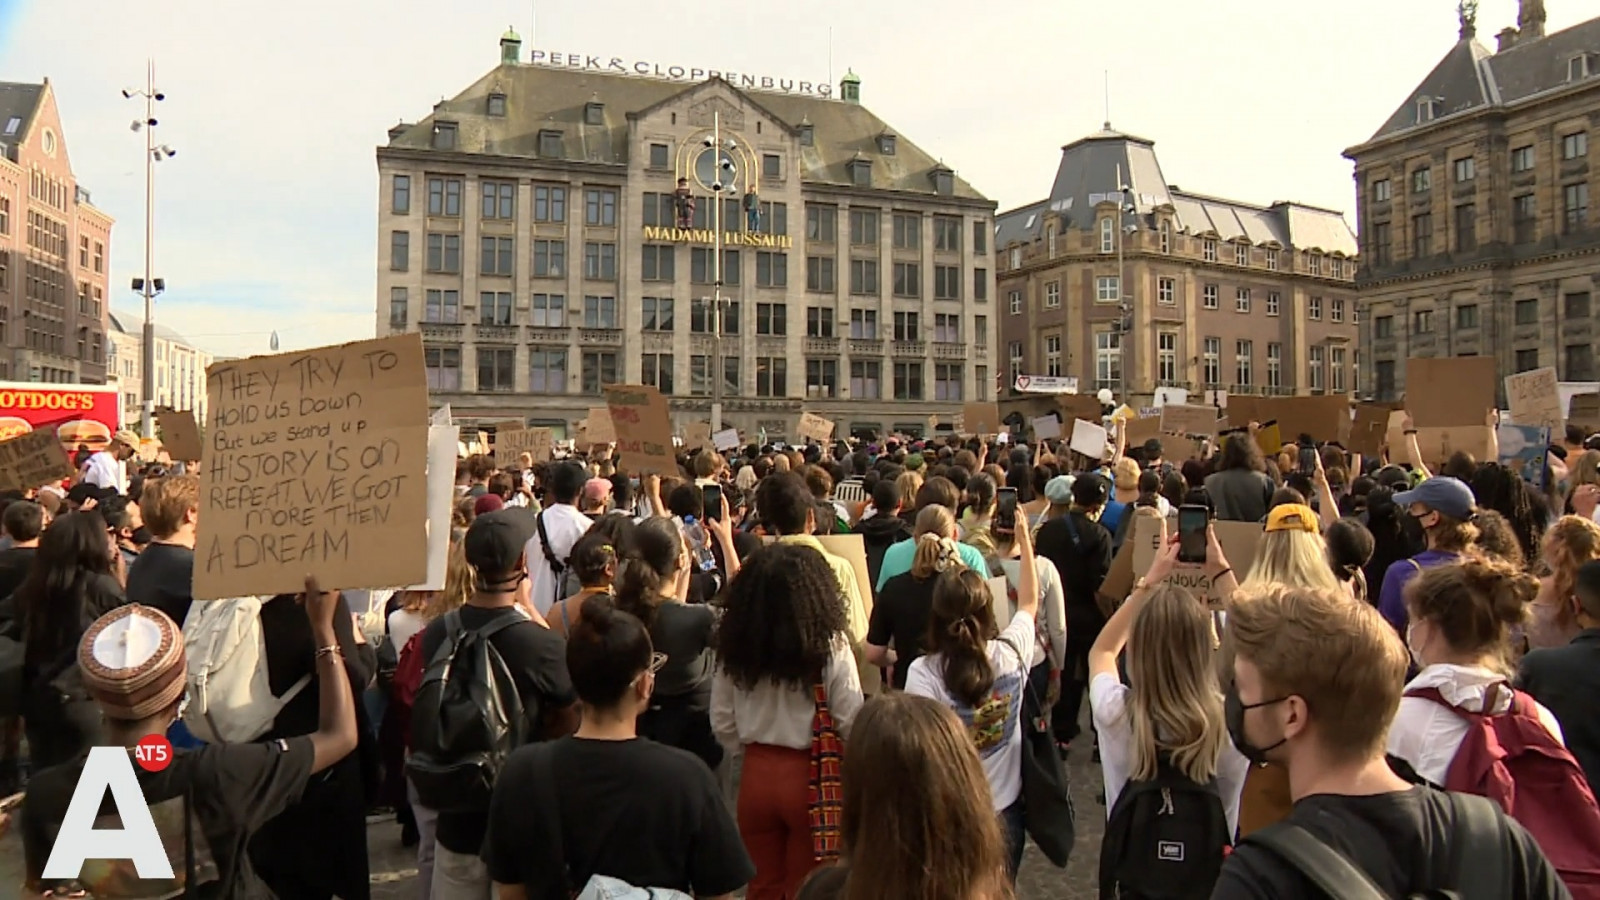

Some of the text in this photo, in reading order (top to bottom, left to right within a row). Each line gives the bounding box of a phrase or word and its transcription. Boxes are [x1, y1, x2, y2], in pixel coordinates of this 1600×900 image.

[530, 49, 832, 96] PEEK & CLOPPENBURG
[209, 350, 398, 401] THEY TRY TO
[0, 391, 94, 410] OTDOG'S
[214, 430, 243, 451] But
[251, 431, 277, 446] we
[341, 420, 366, 435] up
[302, 474, 347, 505] WE
[352, 474, 407, 502] GOT
[324, 503, 391, 525] THEN
[206, 529, 349, 574] A DREAM
[1163, 573, 1213, 592] NOUG
